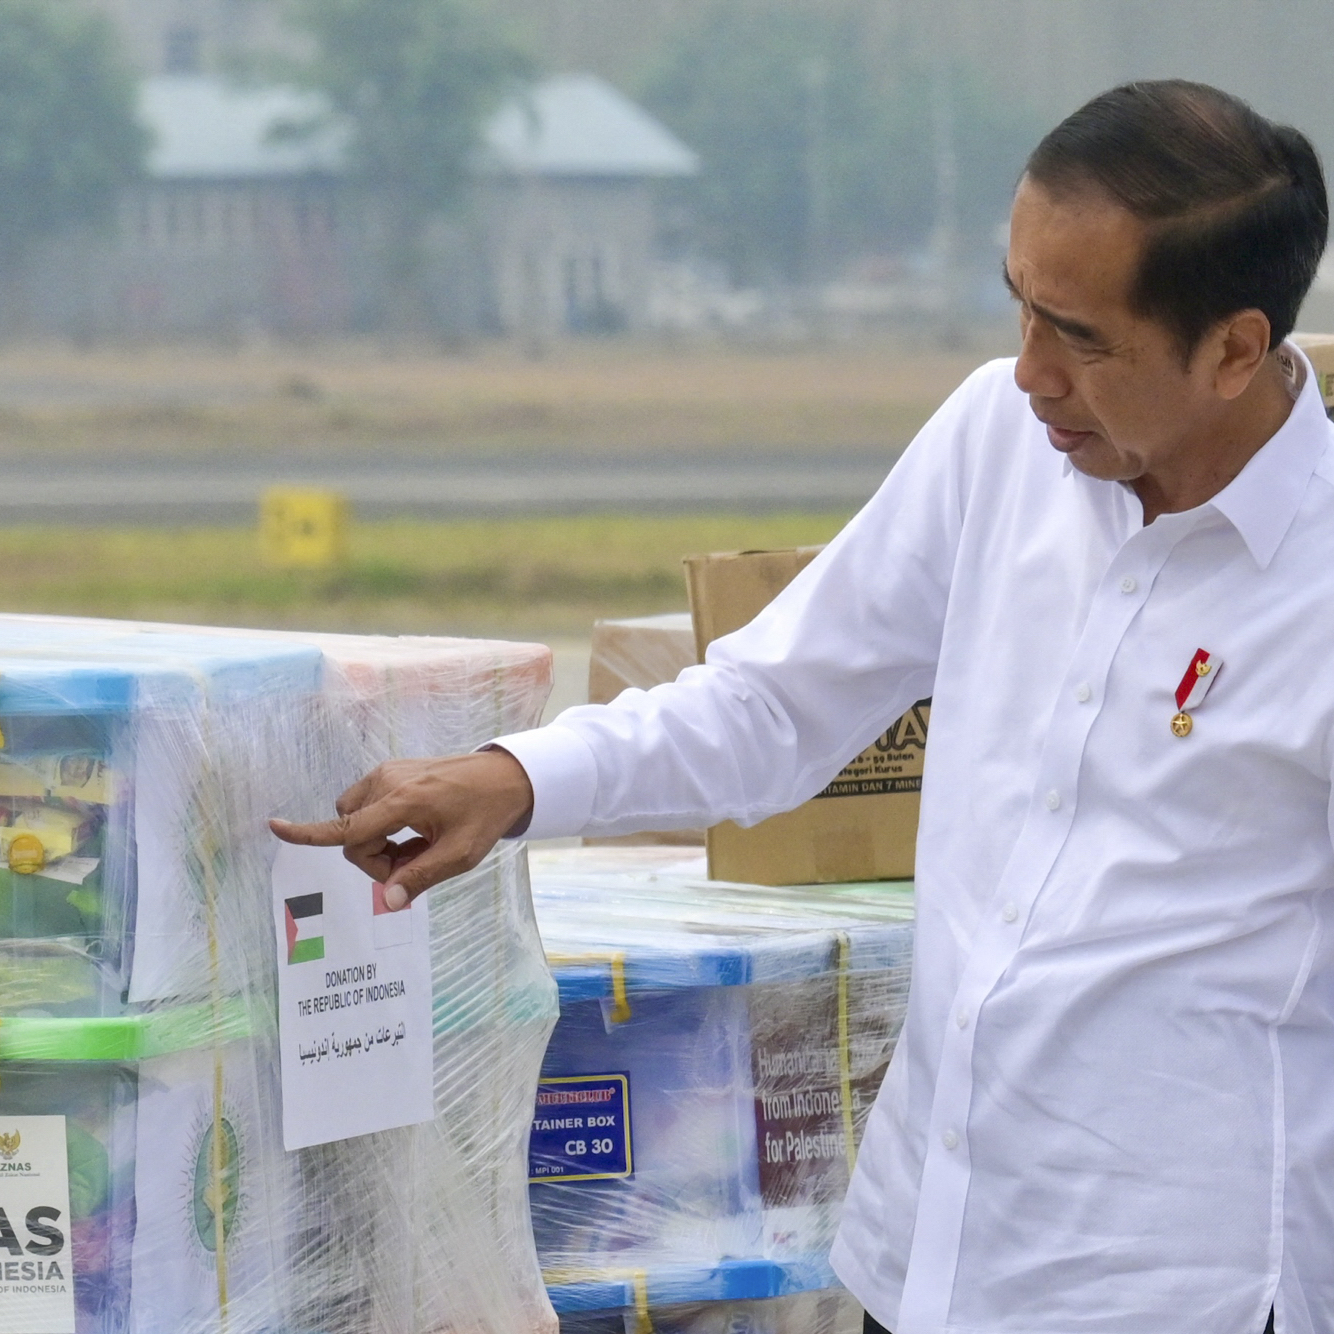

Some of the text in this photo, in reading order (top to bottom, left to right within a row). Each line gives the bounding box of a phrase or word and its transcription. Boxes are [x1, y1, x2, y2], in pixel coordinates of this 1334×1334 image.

[325, 963, 377, 988] DONATION BY
[298, 980, 405, 1017] THE REPUBLIC OF INDONESIA
[364, 1035, 374, 1052] من
[587, 1115, 615, 1128] BOX
[565, 1139, 613, 1156] CB 30
[765, 1130, 846, 1164] for Palestine
